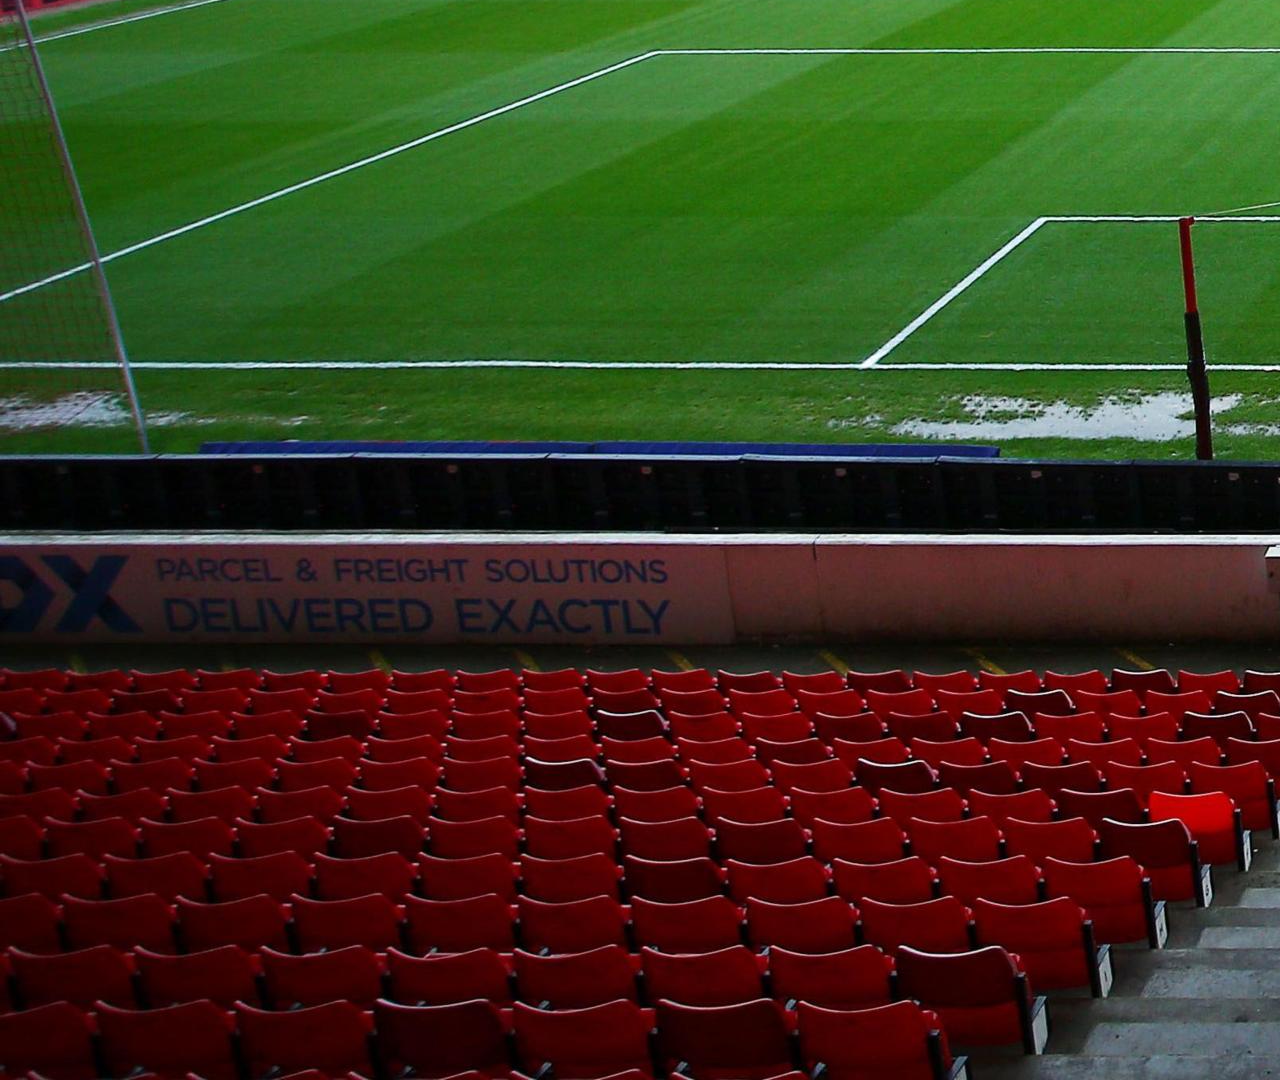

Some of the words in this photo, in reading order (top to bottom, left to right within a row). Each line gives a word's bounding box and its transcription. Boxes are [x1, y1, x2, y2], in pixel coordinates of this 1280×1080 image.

[157, 558, 281, 584] PARCEL
[296, 558, 318, 584] &
[336, 558, 468, 584] FREIGHT
[485, 558, 668, 584] SOLUTIONS
[163, 598, 432, 634] DELIVERED
[456, 598, 670, 636] EXACTLY
